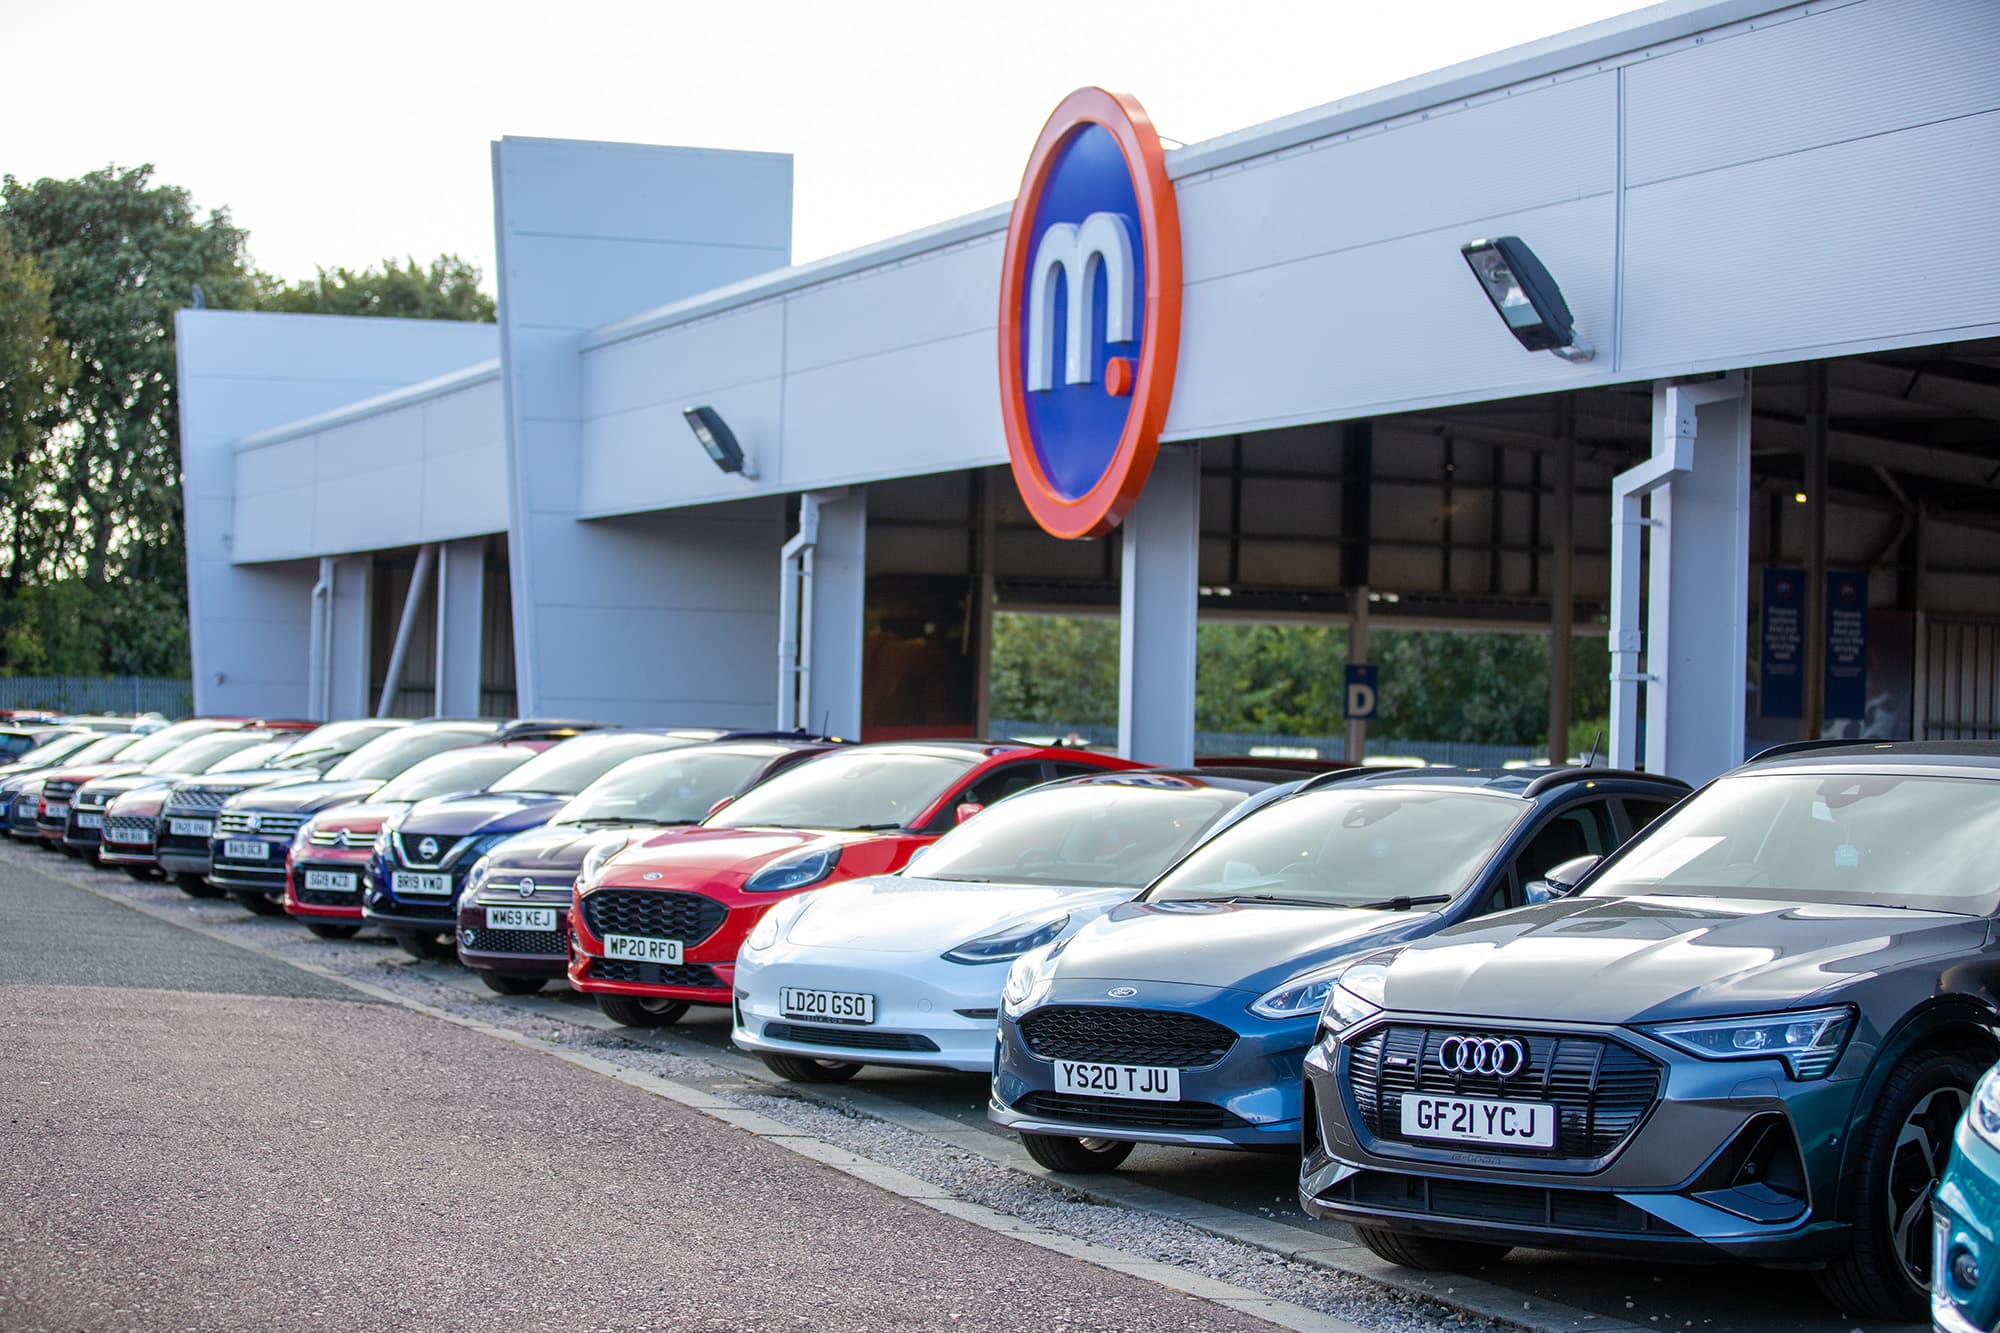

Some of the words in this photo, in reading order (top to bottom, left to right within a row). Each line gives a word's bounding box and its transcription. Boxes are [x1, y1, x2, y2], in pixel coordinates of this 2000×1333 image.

[1348, 683, 1376, 717] D
[397, 874, 419, 889] BR19
[525, 911, 550, 926] KEJ
[610, 937, 645, 956] WP20
[650, 941, 676, 959] RFO
[786, 991, 826, 1013] LD20
[832, 995, 865, 1016] GSO
[1063, 1063, 1117, 1090] YS20
[1124, 1068, 1168, 1093] TJU
[1417, 1100, 1474, 1133] GF21
[1483, 1105, 1535, 1137] YCJ
